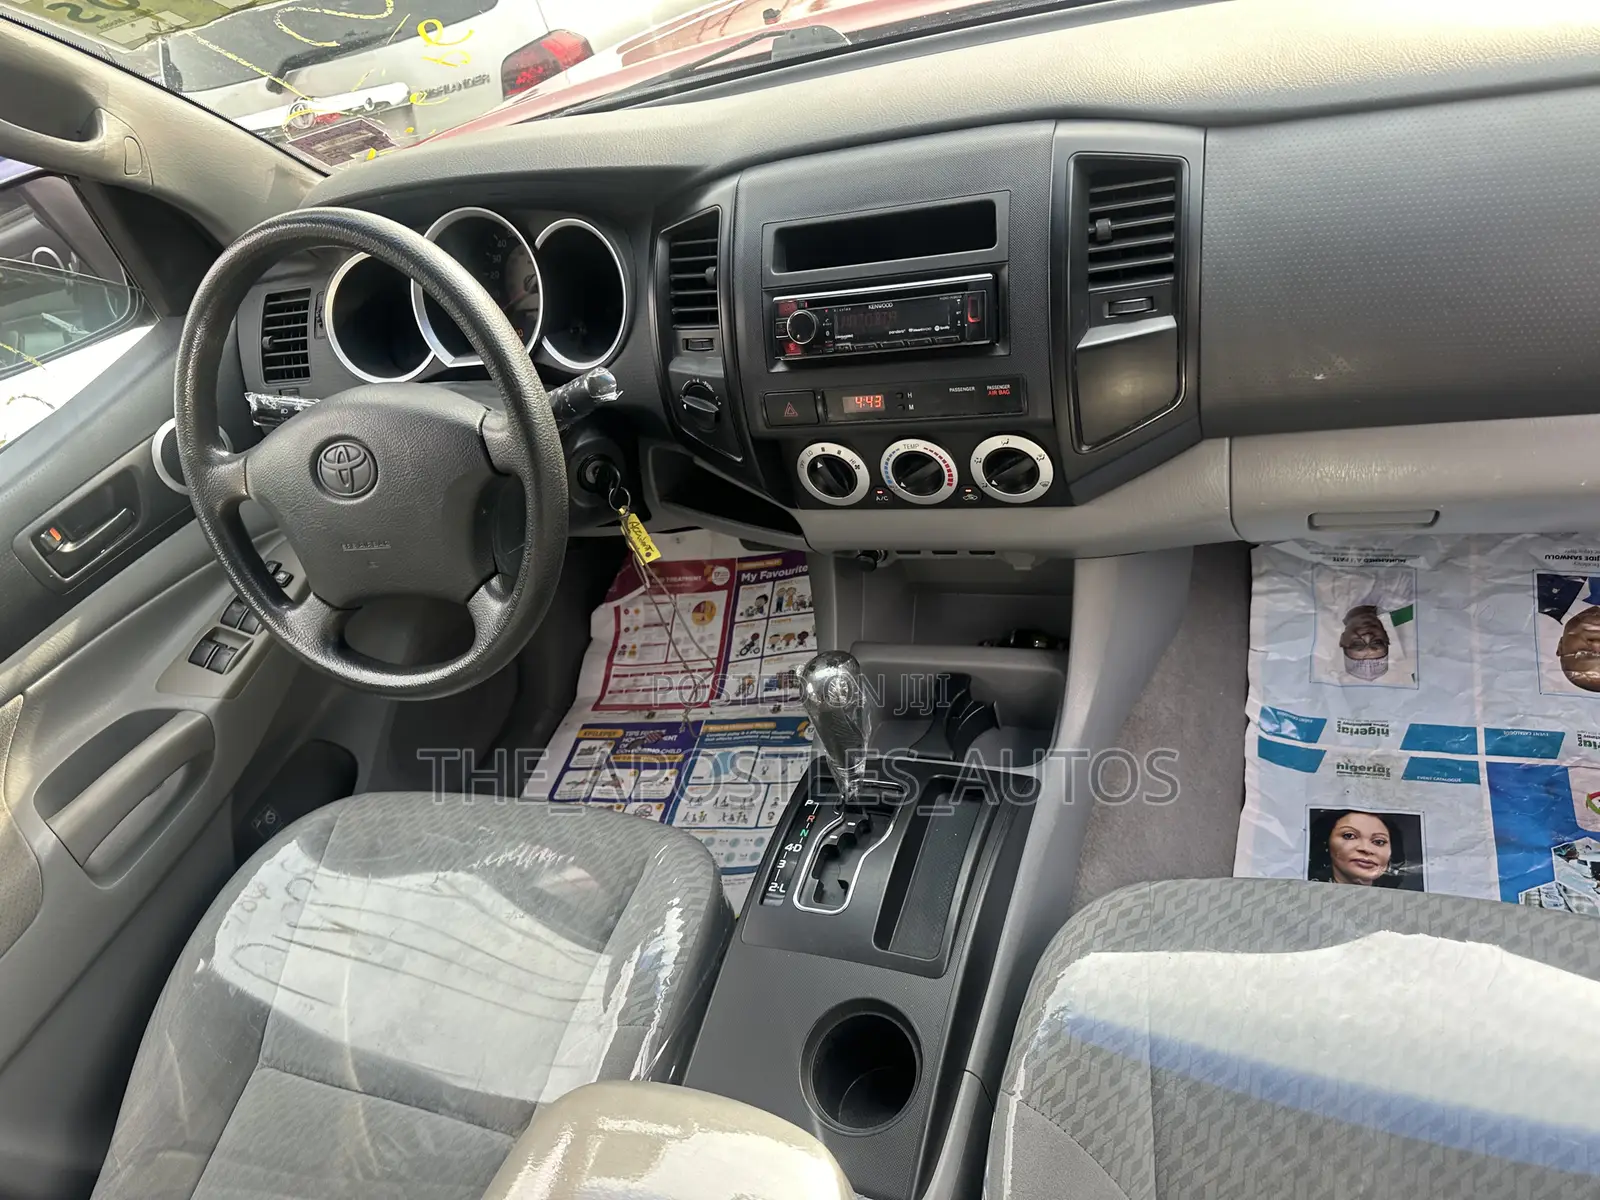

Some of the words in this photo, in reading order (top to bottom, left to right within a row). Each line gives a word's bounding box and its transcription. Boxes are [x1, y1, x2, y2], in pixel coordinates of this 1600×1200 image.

[740, 572, 758, 583] My
[759, 564, 809, 580] Favourite
[800, 829, 809, 837] N
[777, 860, 786, 868] 3
